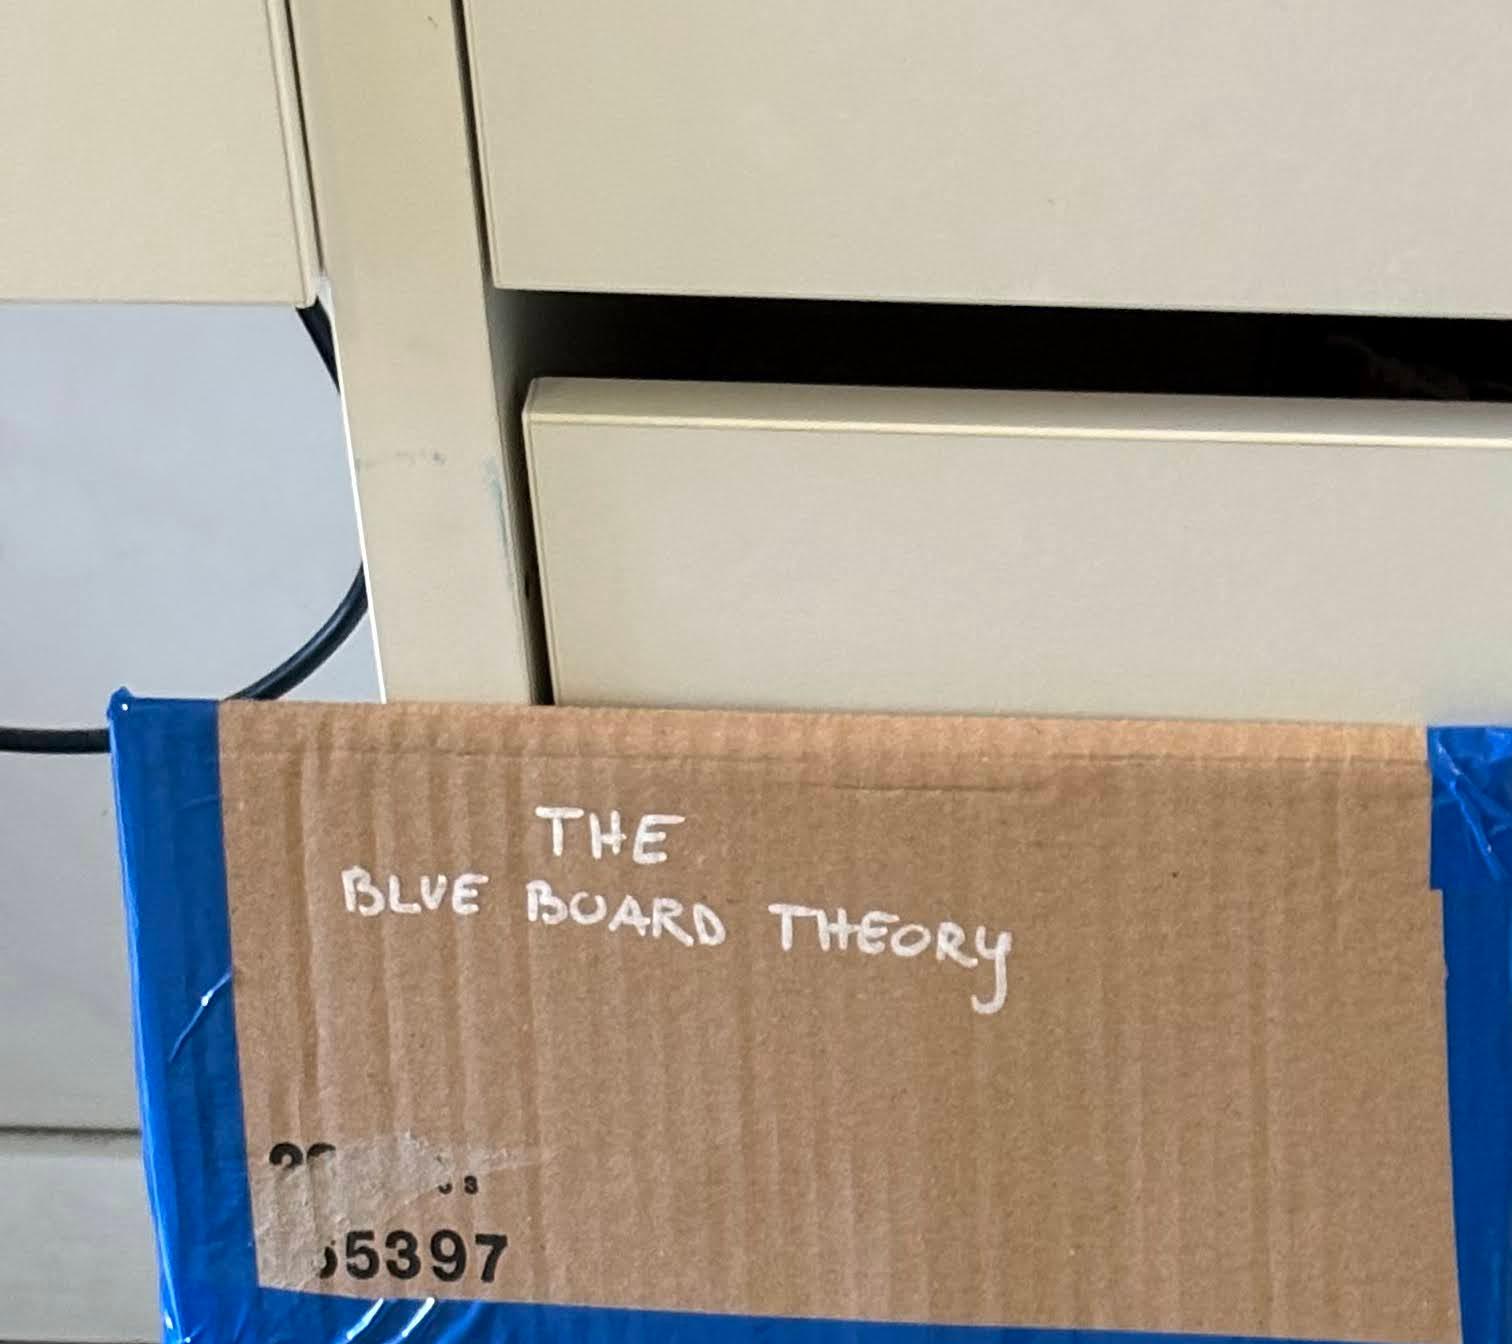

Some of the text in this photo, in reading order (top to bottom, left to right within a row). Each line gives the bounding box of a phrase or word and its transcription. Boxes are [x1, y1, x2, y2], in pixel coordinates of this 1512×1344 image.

[535, 805, 687, 866] THE
[341, 865, 490, 917] BLUE
[526, 879, 728, 947] BOARD
